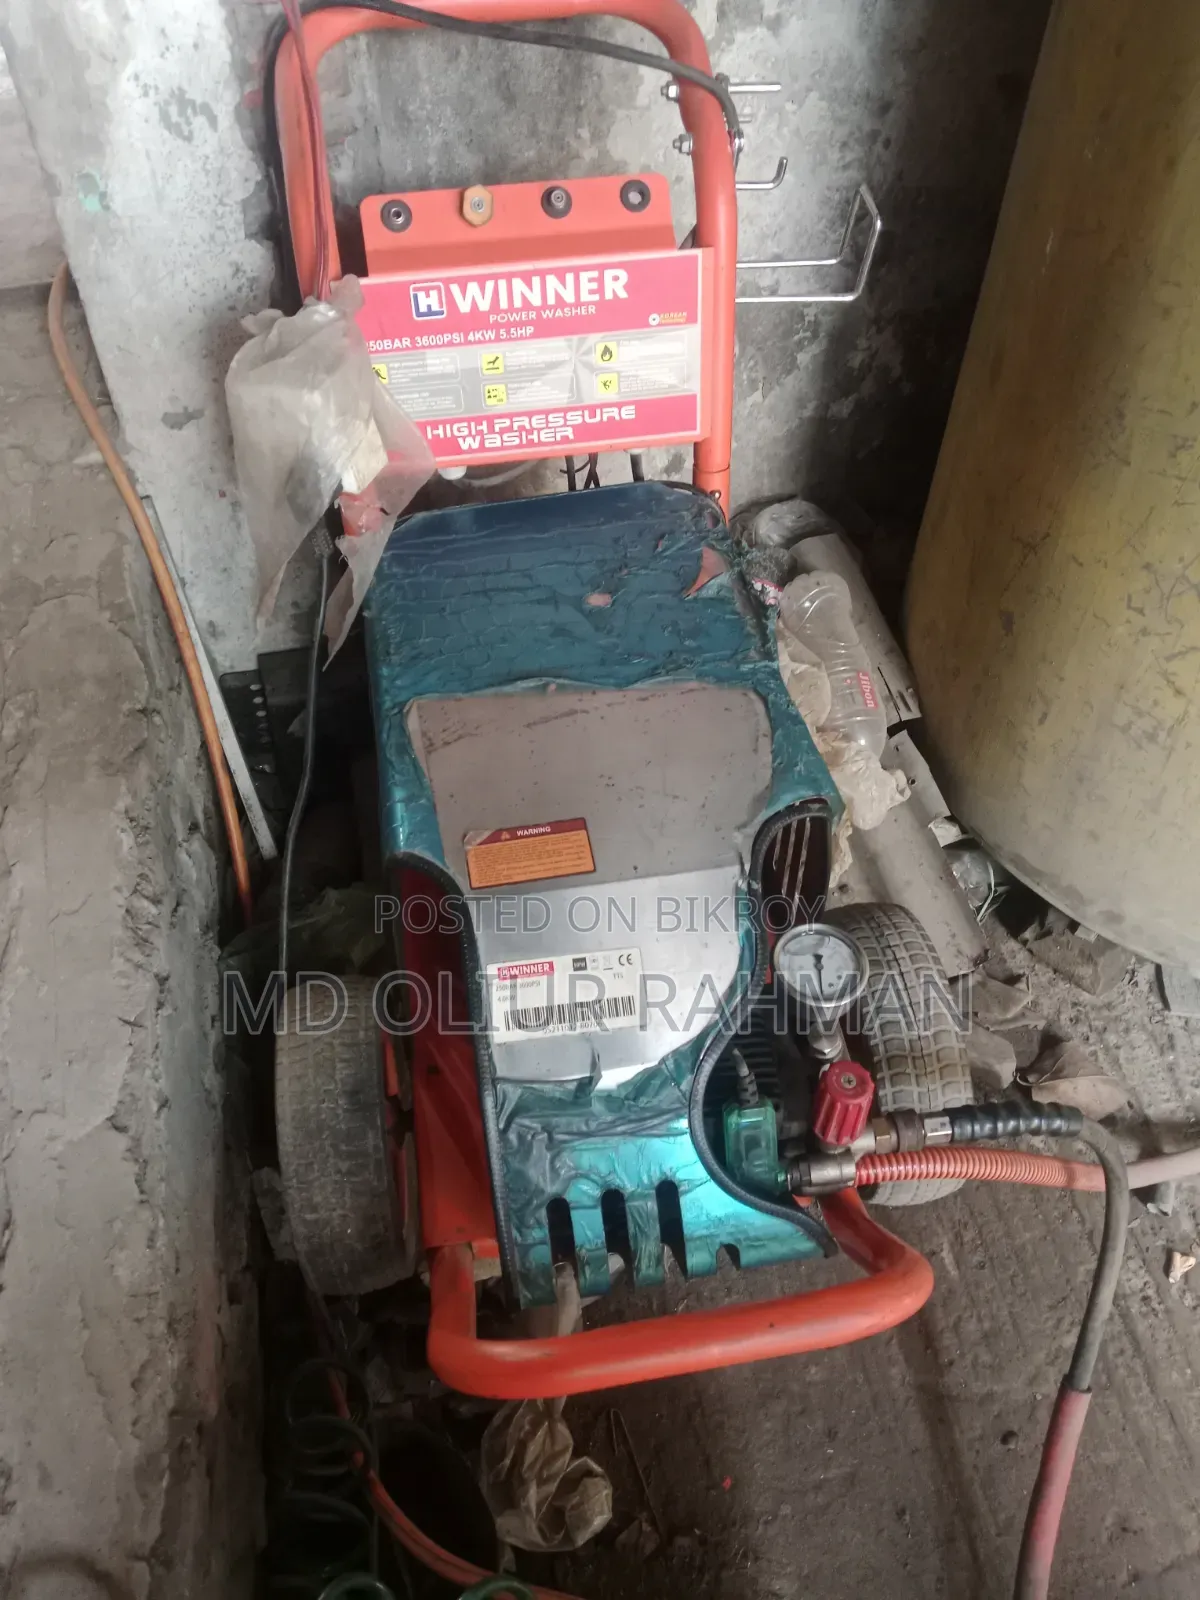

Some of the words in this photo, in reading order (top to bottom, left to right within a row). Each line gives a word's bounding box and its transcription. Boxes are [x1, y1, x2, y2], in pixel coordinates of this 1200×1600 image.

[449, 268, 629, 314] WINNER
[489, 310, 537, 324] POWER
[541, 305, 596, 319] WASHER
[366, 336, 412, 352] 50BAR
[415, 333, 464, 347] 3600PSI
[467, 329, 496, 342] 4KW
[499, 326, 534, 339] 5.5HP
[426, 417, 488, 440] HIGH
[494, 405, 636, 433] PRESSURE
[516, 826, 551, 837] WARNING
[509, 962, 550, 976] WINNER
